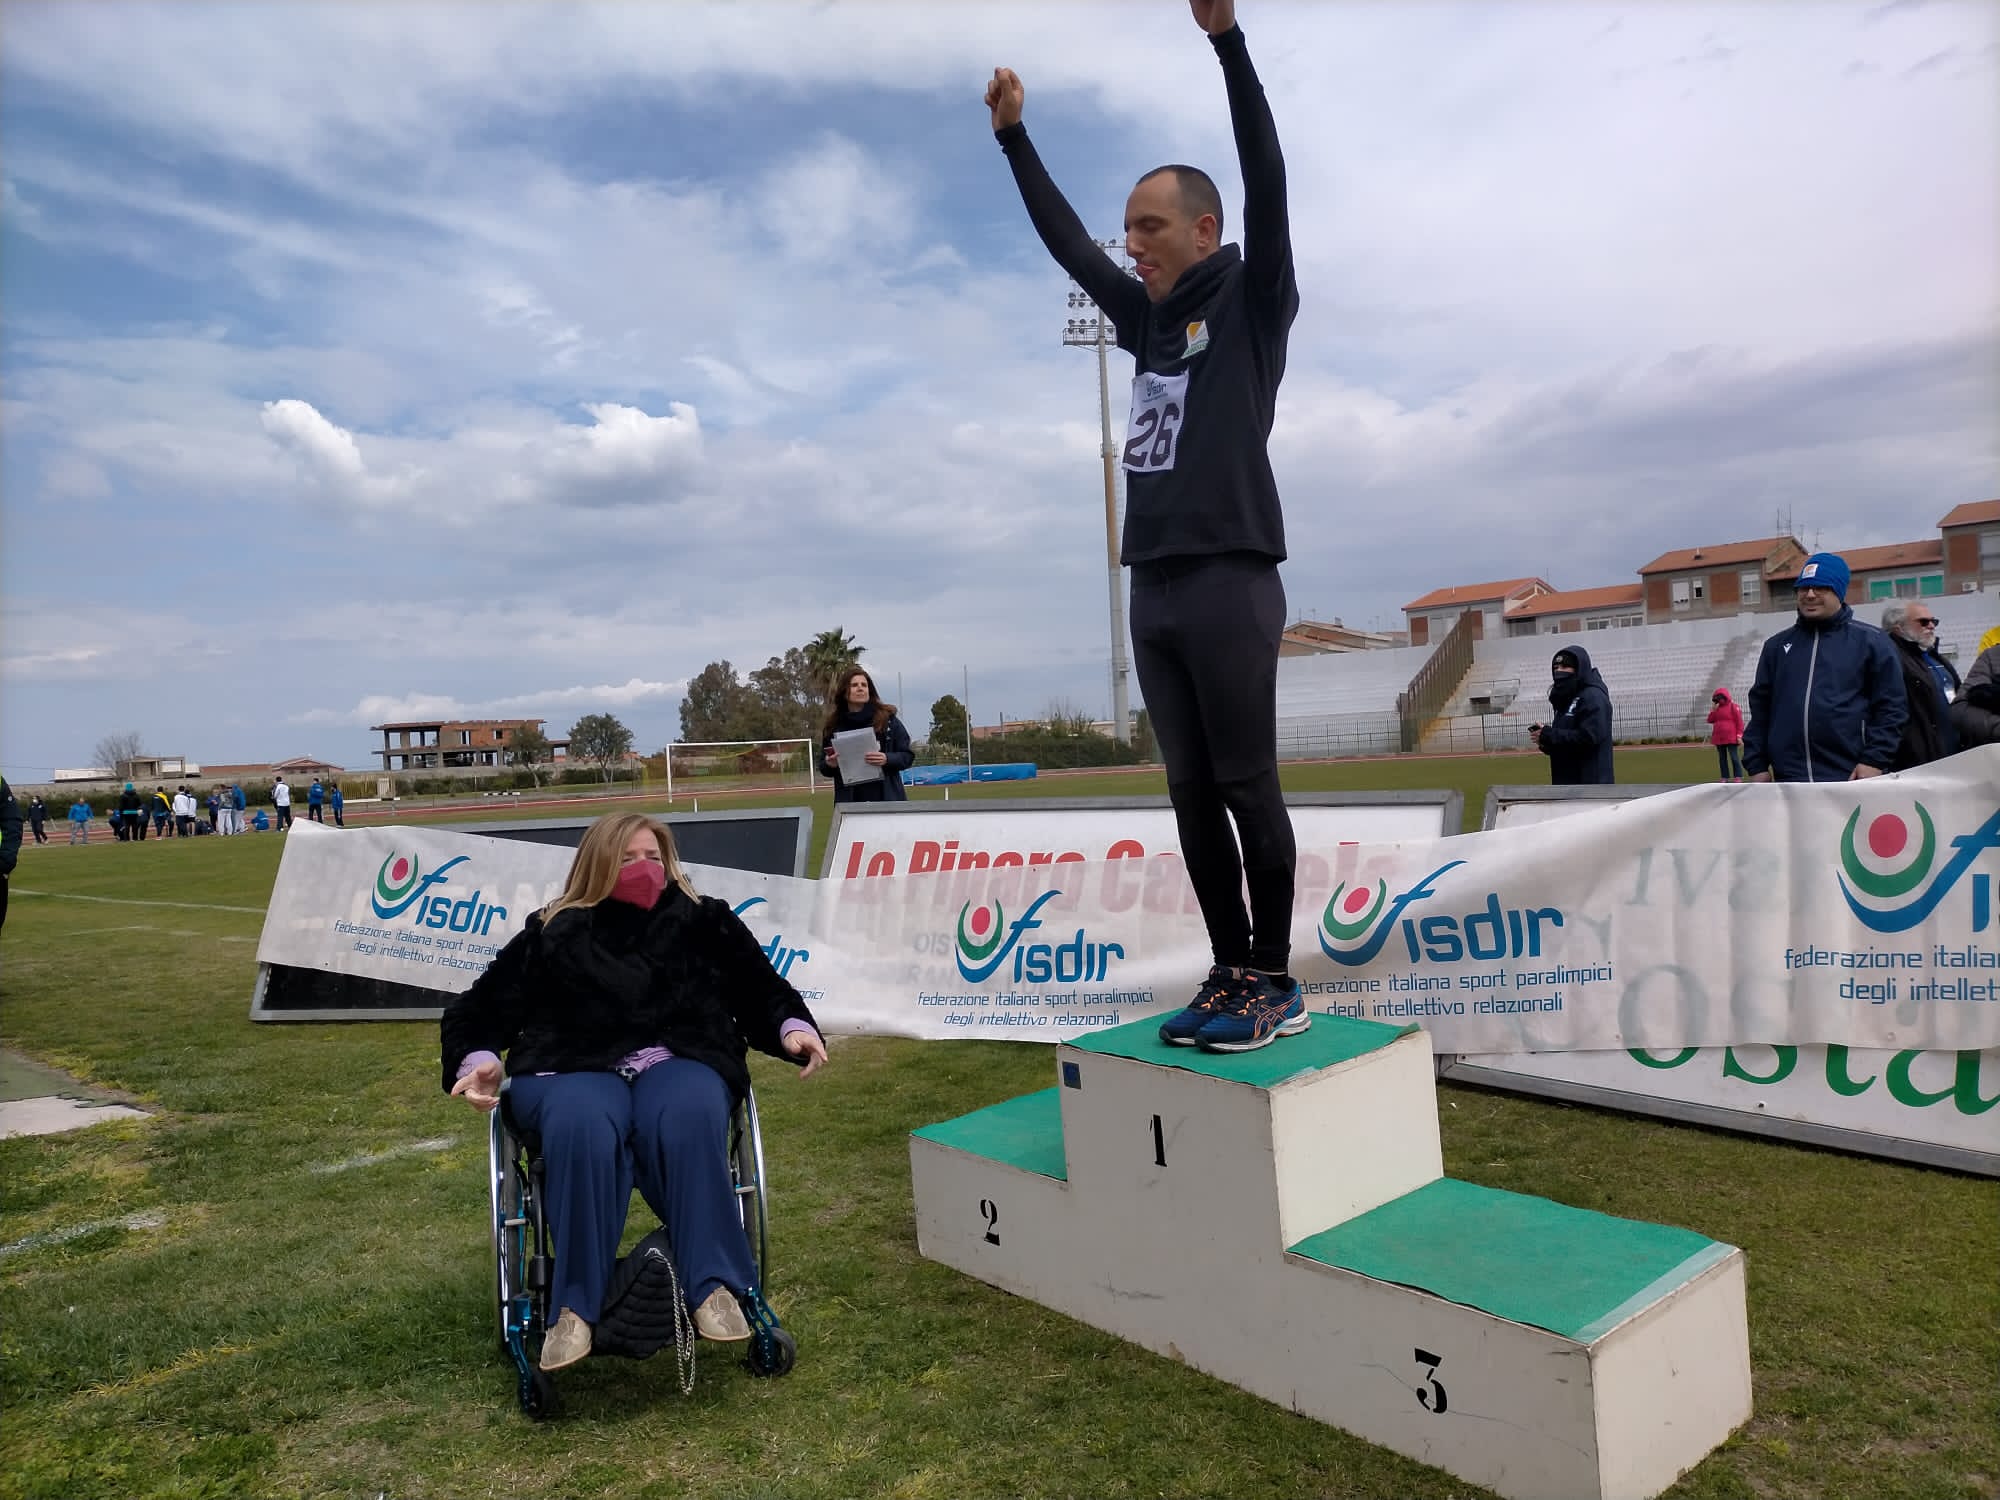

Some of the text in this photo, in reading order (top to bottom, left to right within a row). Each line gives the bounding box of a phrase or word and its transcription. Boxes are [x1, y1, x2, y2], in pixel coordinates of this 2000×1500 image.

[1122, 402, 1180, 467] 26
[372, 855, 508, 936] fisdir
[1317, 860, 1564, 967] fisdir
[334, 919, 502, 956] federazione italiana sport parali
[954, 889, 1125, 984] fisdir
[353, 940, 490, 972] degli intellettivo relazional
[1784, 944, 1923, 970] federazione
[1299, 961, 1613, 995] derazione italiana sport paralimpici
[1839, 976, 1897, 1005] degli
[918, 986, 1154, 1008] federazione italiana sport paralimpici
[1326, 992, 1563, 1019] degli intellettivo relazionali
[943, 1010, 1120, 1027] degli intellettivo relazionali
[1149, 1113, 1168, 1167] 1
[980, 1199, 1001, 1246] 2
[1414, 1347, 1448, 1414] 3
